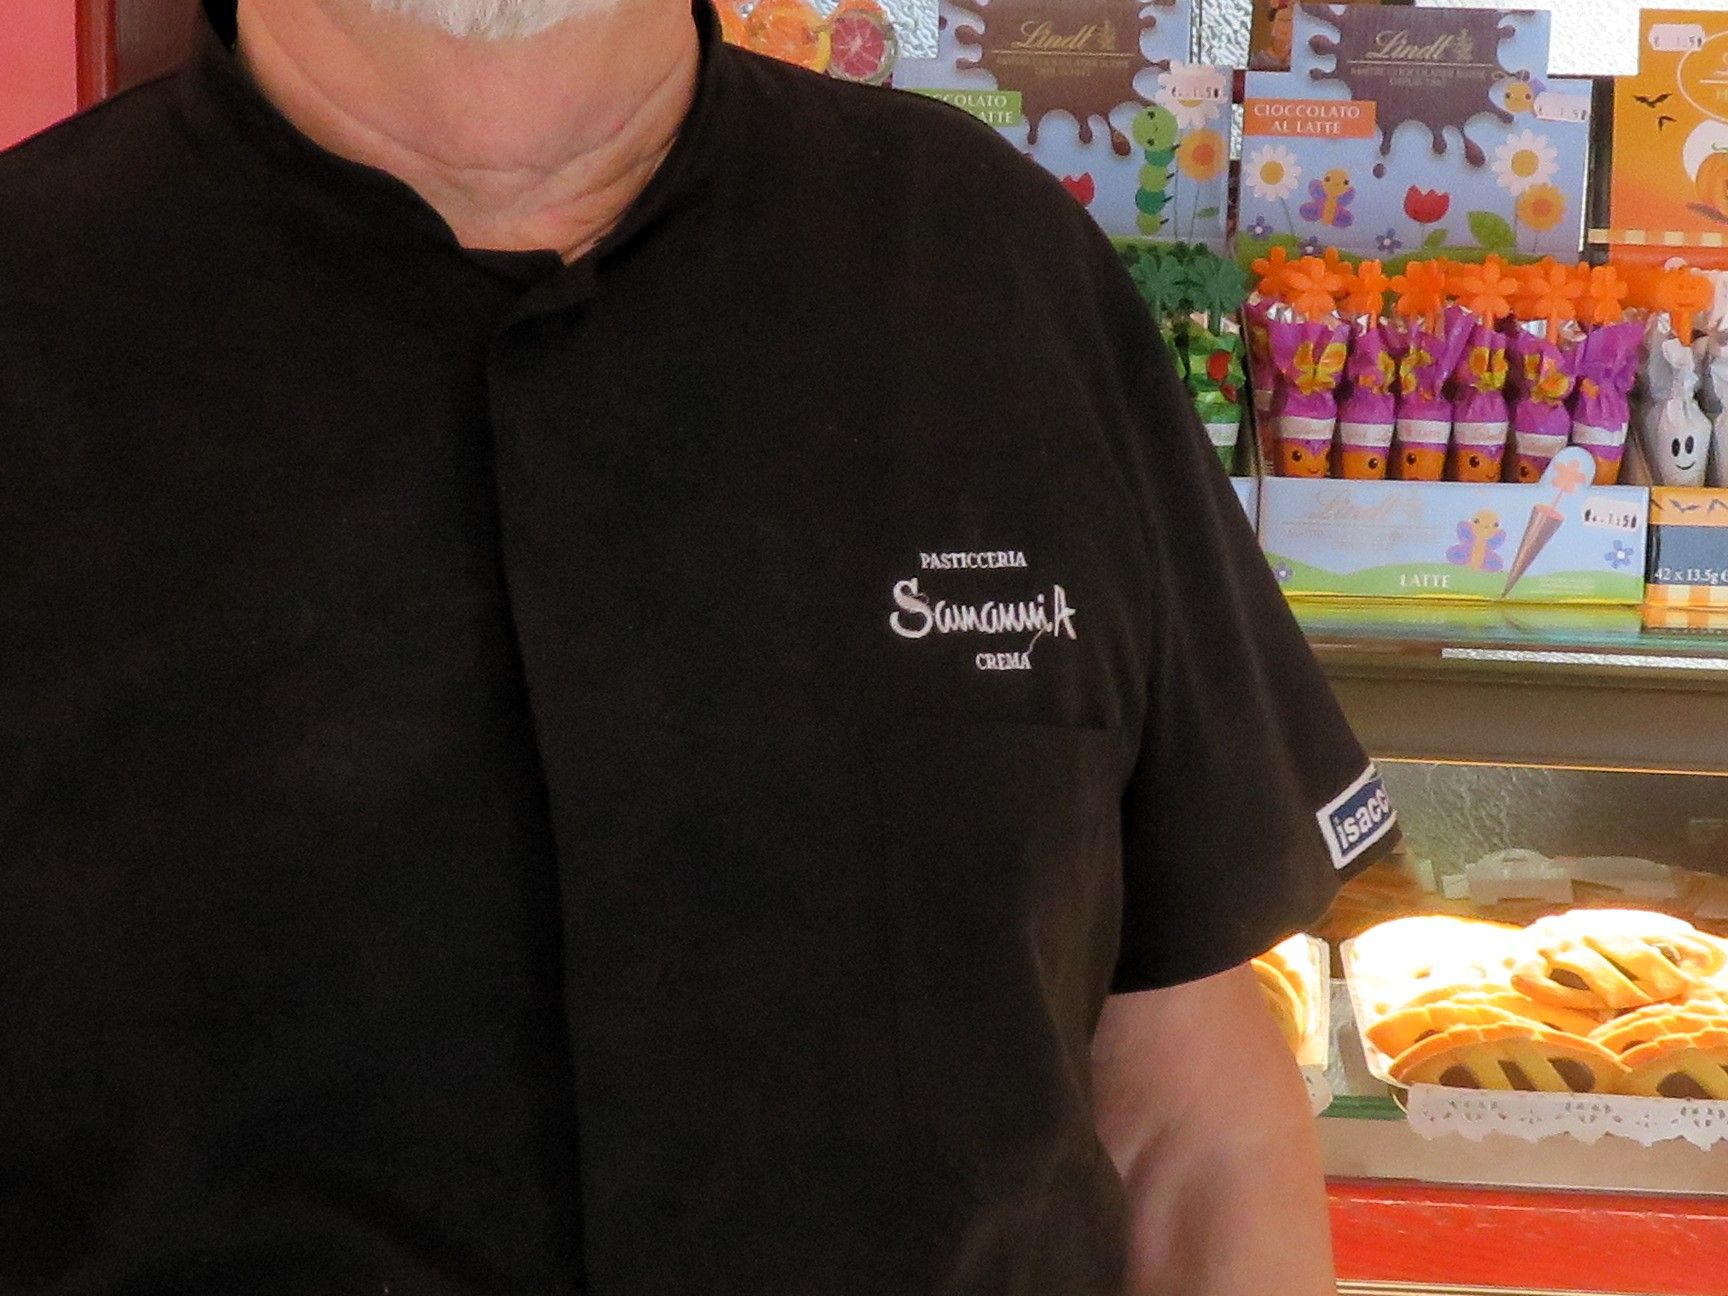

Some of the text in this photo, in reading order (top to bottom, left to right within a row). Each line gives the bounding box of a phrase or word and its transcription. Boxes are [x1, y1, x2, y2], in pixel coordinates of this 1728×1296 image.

[1010, 20, 1099, 51] Lindt
[1367, 29, 1455, 61] Lindt
[1253, 104, 1360, 120] CIOCCOLATO
[1272, 121, 1341, 135] AL LATTE
[919, 550, 1028, 570] PASTICCERIA
[1399, 573, 1451, 589] LATTE
[1654, 567, 1671, 581] 42
[975, 652, 1032, 671] CREMA
